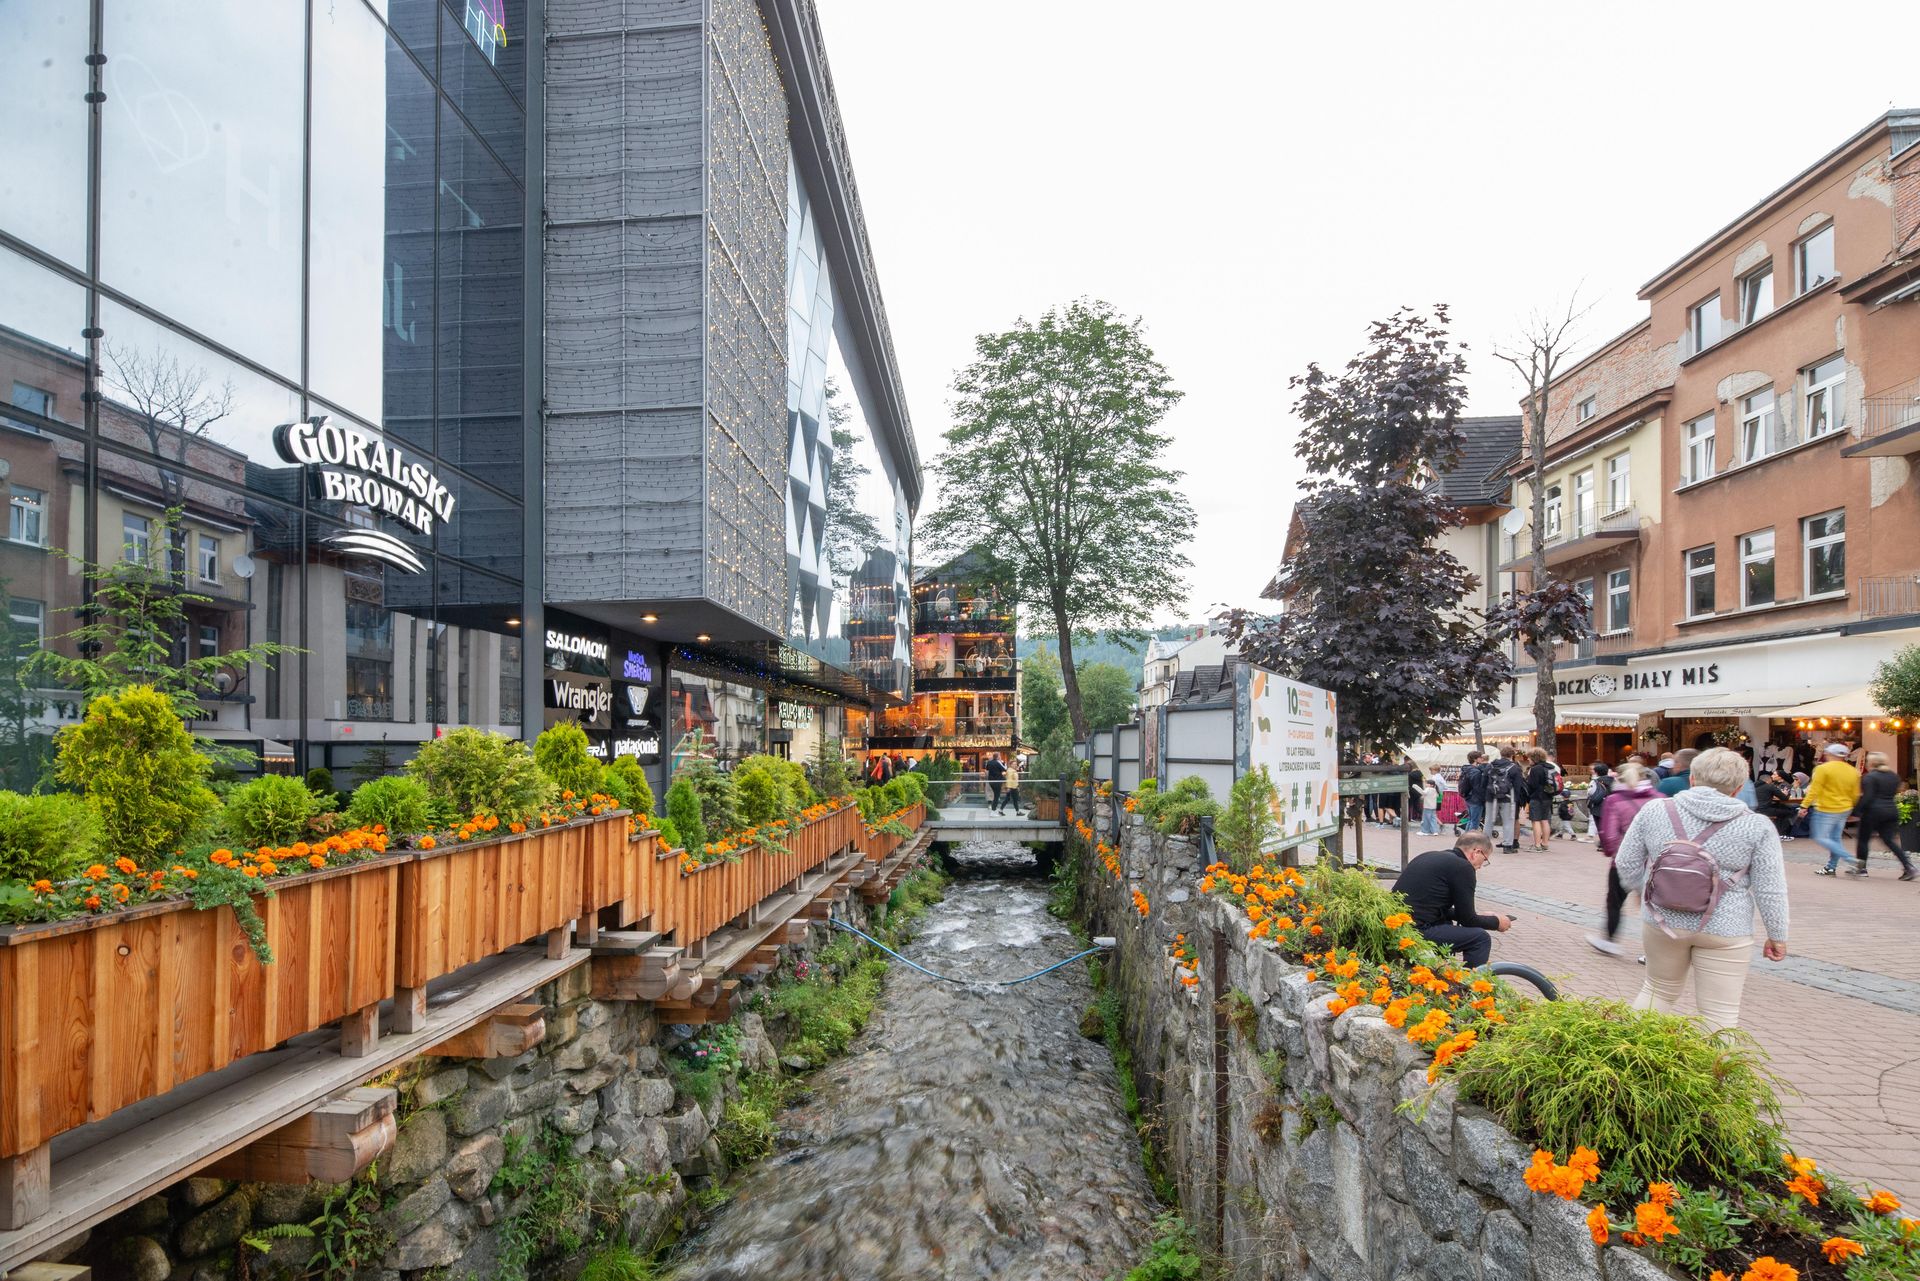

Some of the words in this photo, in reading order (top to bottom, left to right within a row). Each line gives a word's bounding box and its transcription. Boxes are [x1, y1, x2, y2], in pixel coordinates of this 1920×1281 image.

[285, 415, 456, 524] GÓRALSKI
[322, 470, 433, 536] BROWAR
[545, 629, 608, 660] SALOMON
[1623, 670, 1672, 690] BIAŁY
[1682, 663, 1719, 685] MIŚ
[553, 679, 614, 722] Wrangler
[614, 737, 660, 759] patagonia
